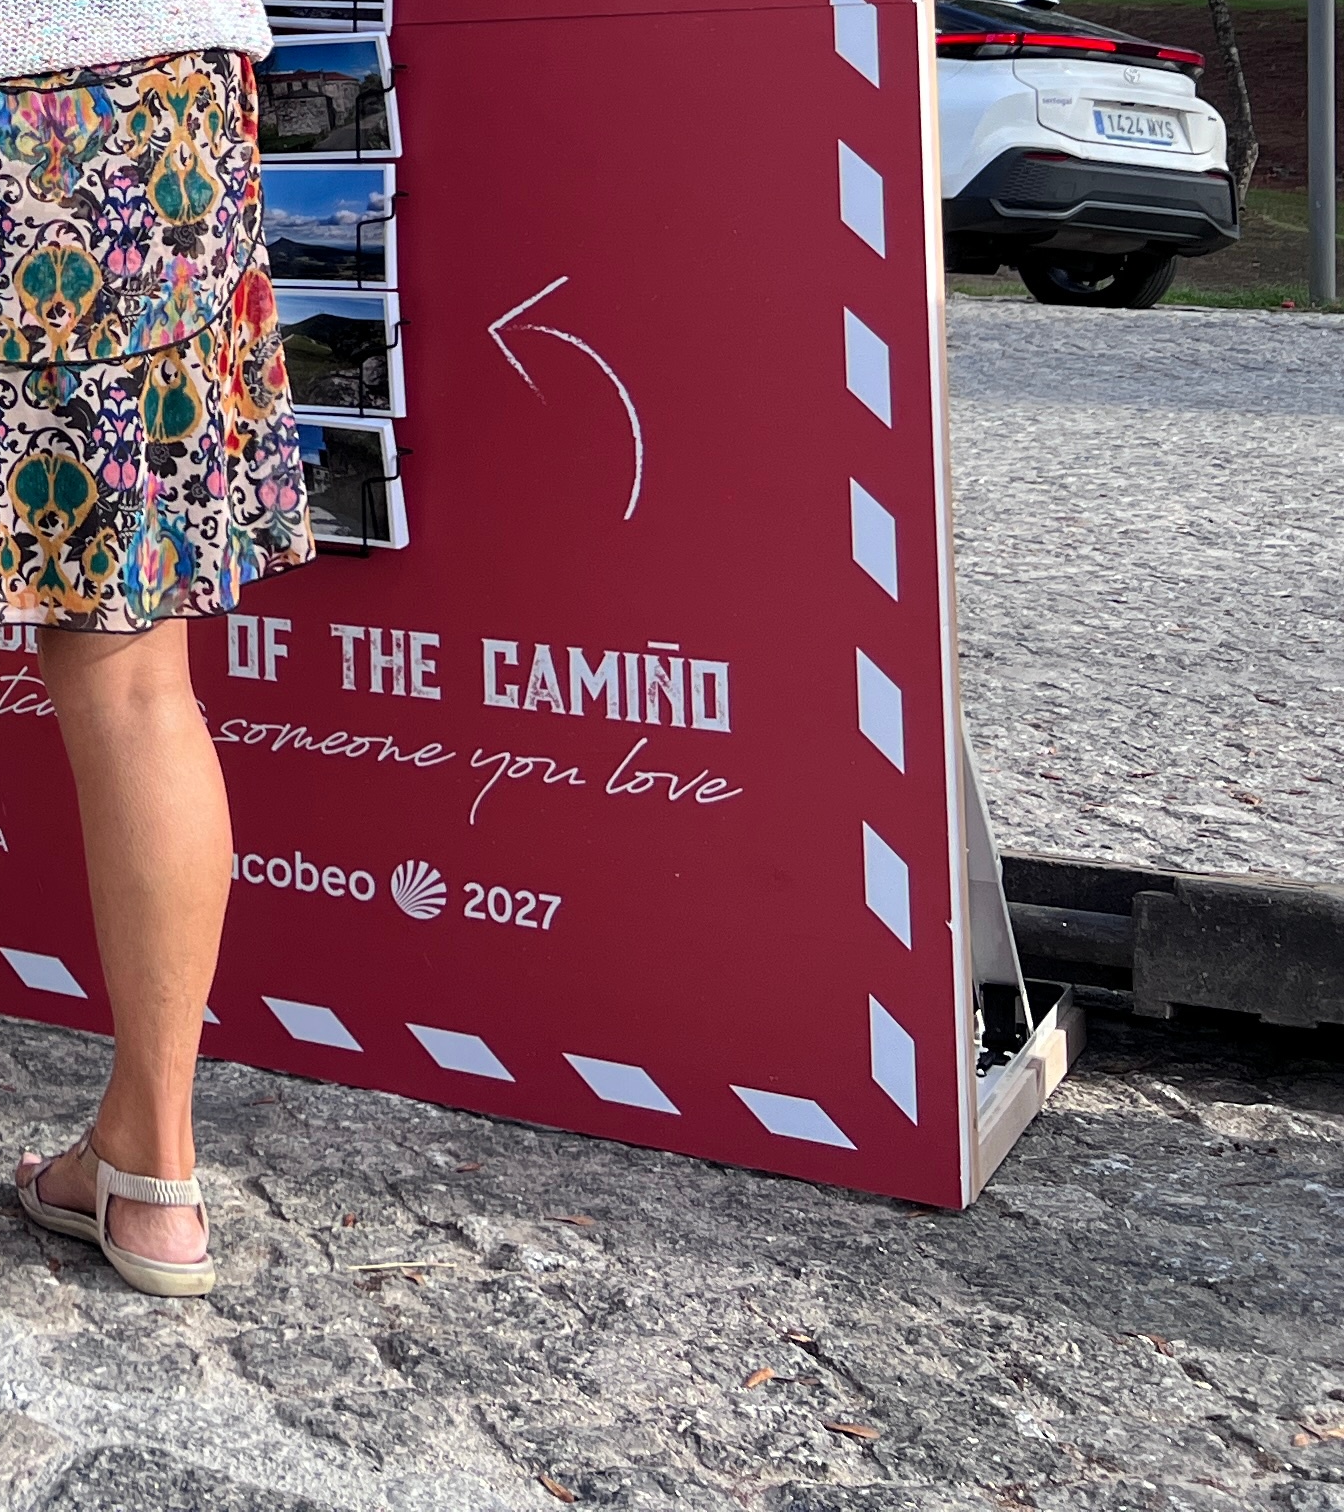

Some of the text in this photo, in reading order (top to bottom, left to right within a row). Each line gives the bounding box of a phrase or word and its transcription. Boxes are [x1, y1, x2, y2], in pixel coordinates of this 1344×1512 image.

[1107, 113, 1175, 139] 1424 MYS
[226, 613, 292, 682] OF
[329, 622, 442, 701] THE
[481, 639, 732, 734] CAMIÑO
[212, 716, 458, 769] someone
[471, 745, 586, 826] you
[604, 737, 743, 805] love
[464, 881, 563, 931] 2027
